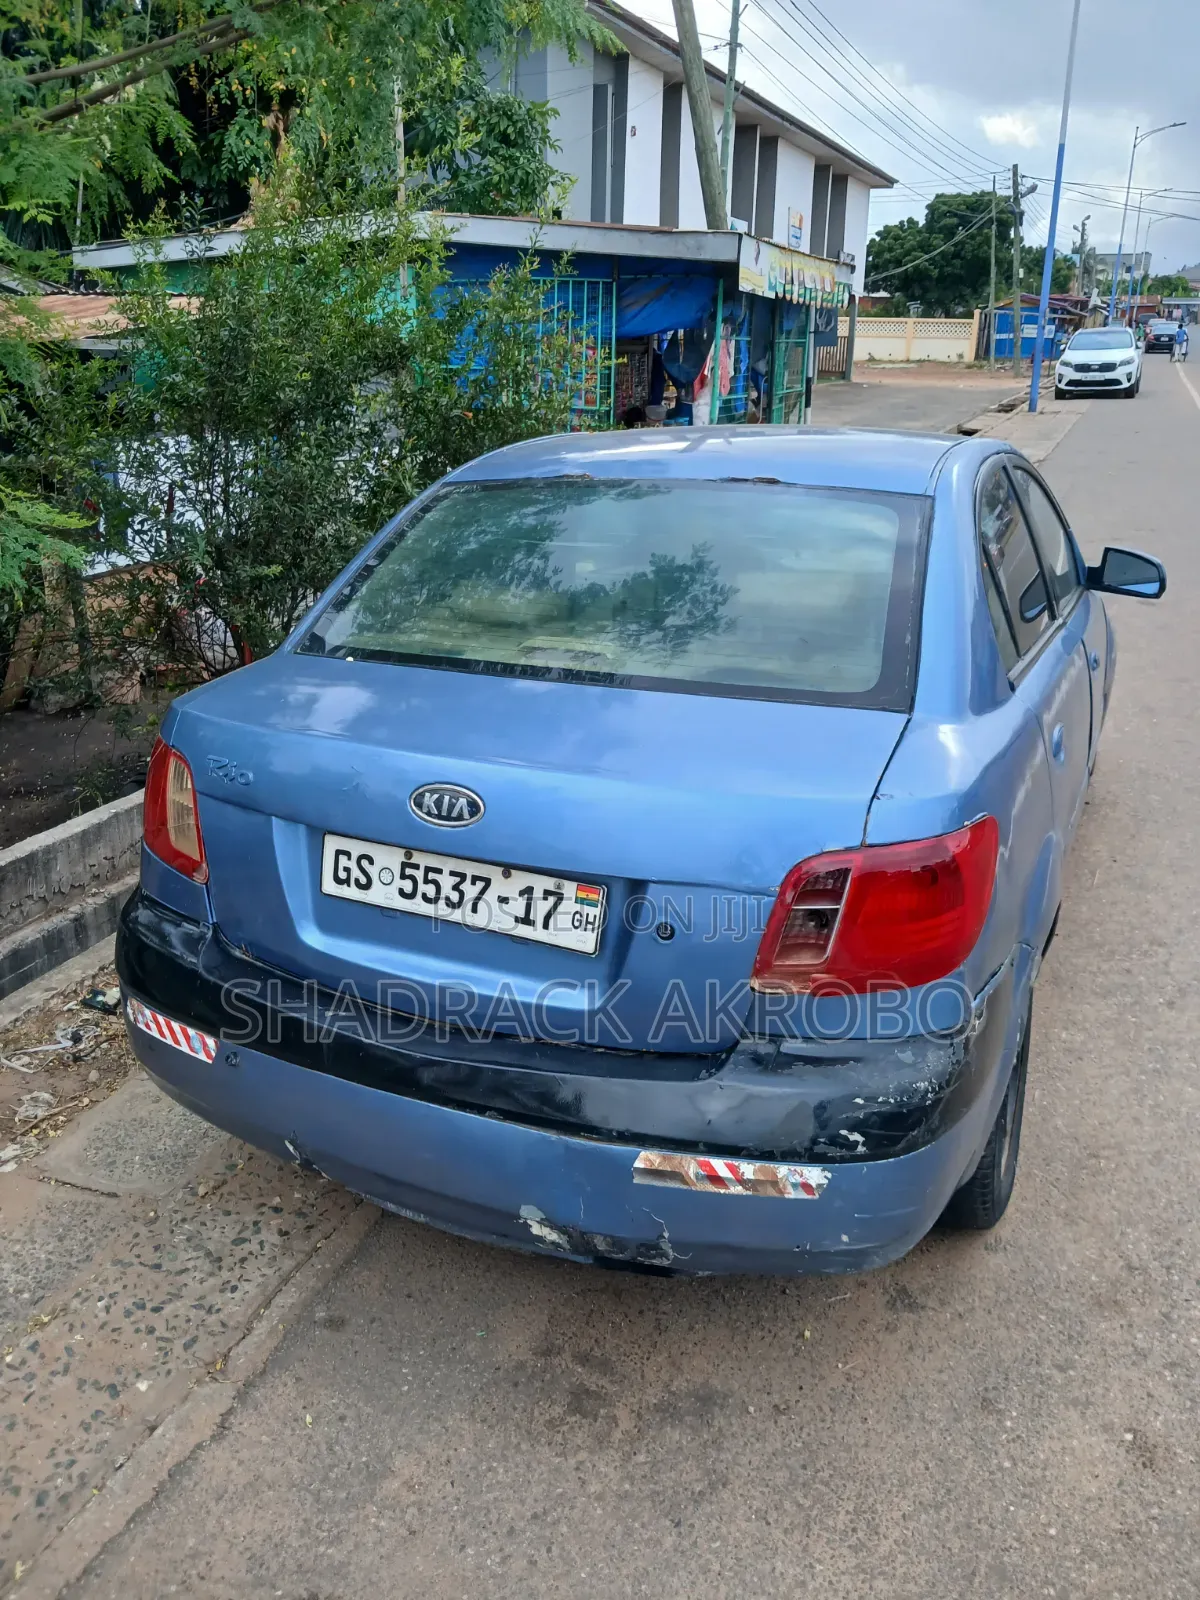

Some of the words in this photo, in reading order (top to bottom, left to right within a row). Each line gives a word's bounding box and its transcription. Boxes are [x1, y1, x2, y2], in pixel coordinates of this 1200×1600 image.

[206, 754, 253, 786] Rio
[420, 791, 471, 820] KIA
[332, 848, 375, 891] GS
[571, 910, 597, 934] GH
